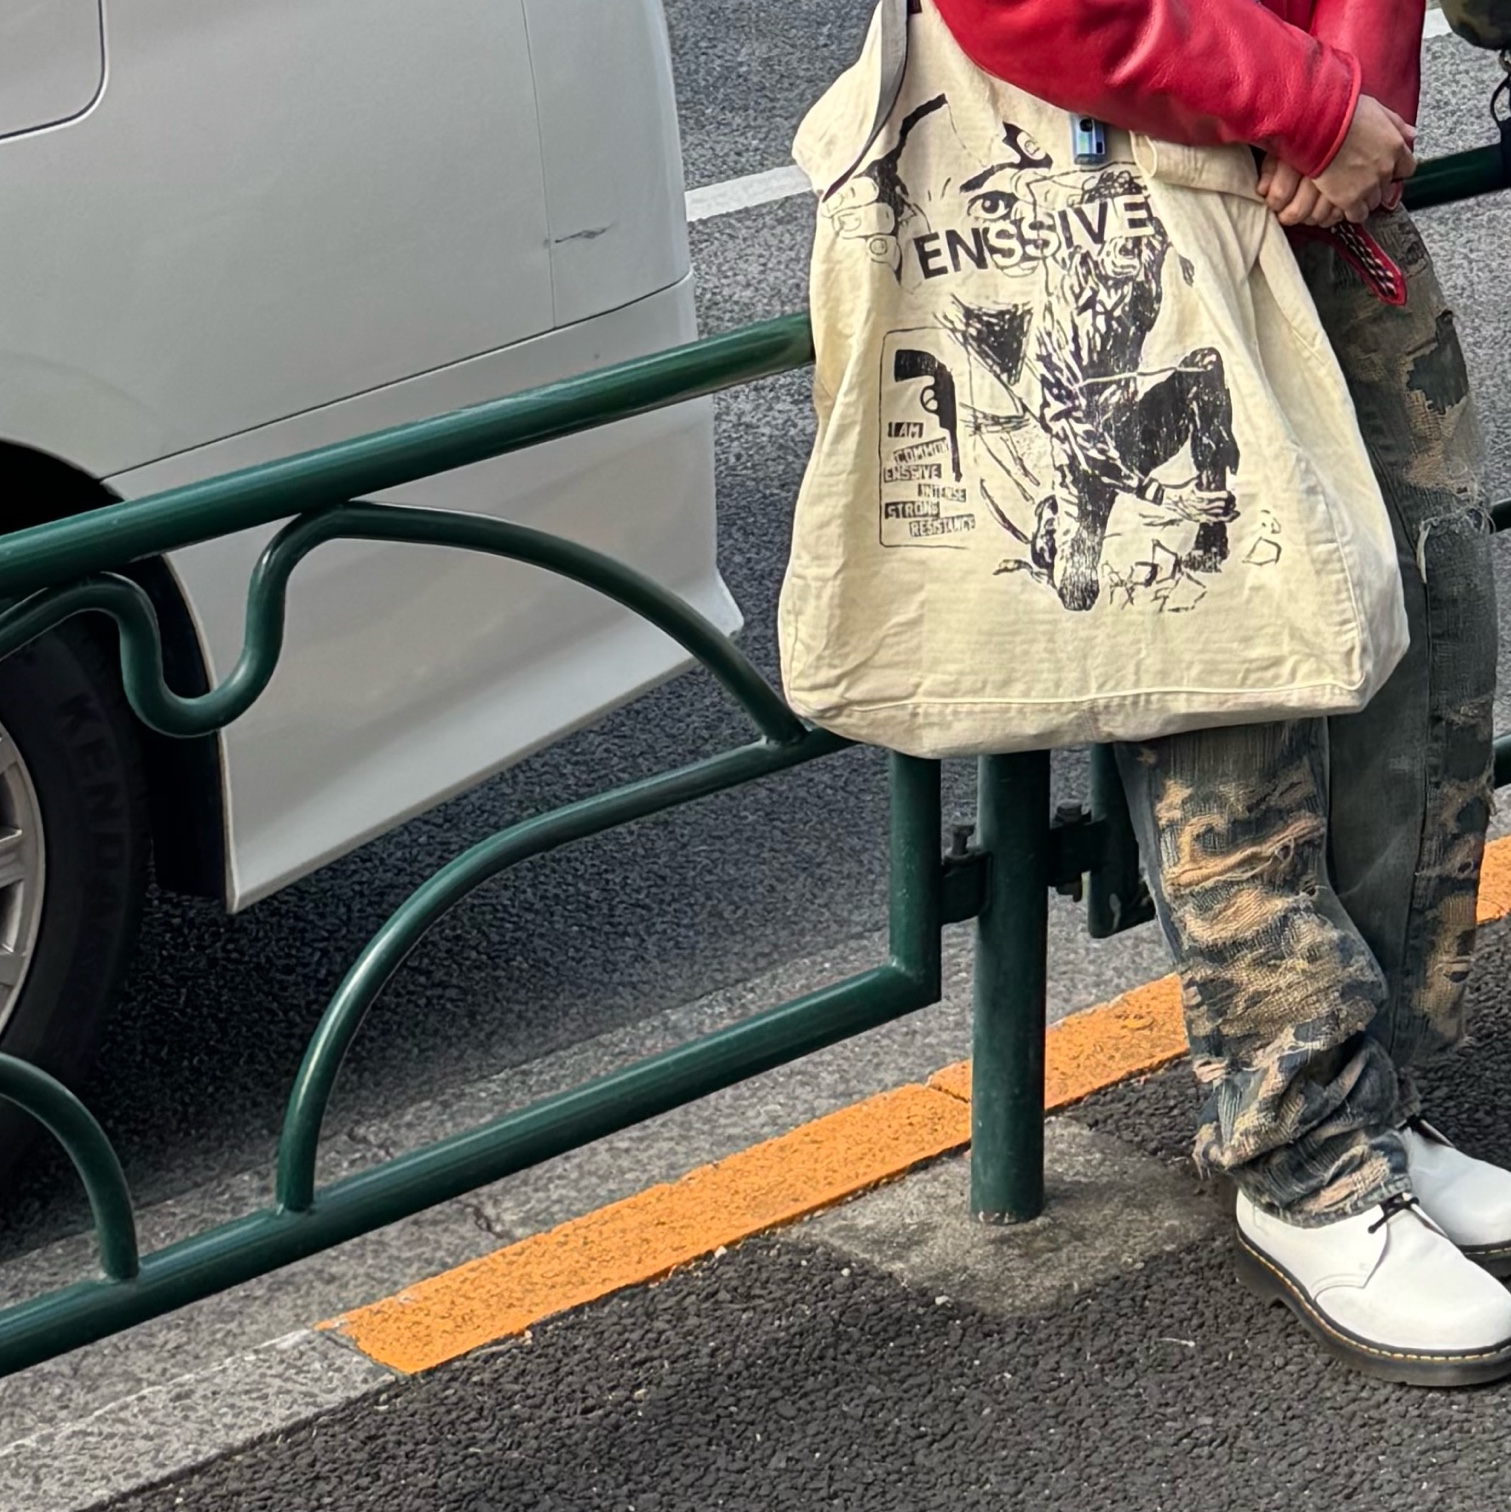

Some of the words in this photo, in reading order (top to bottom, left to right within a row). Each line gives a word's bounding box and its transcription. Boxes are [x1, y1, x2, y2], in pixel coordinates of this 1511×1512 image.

[913, 194, 1156, 280] ENSSIVE
[898, 421, 923, 438] AM
[893, 437, 950, 465] COMMON
[884, 500, 940, 519] STRONG
